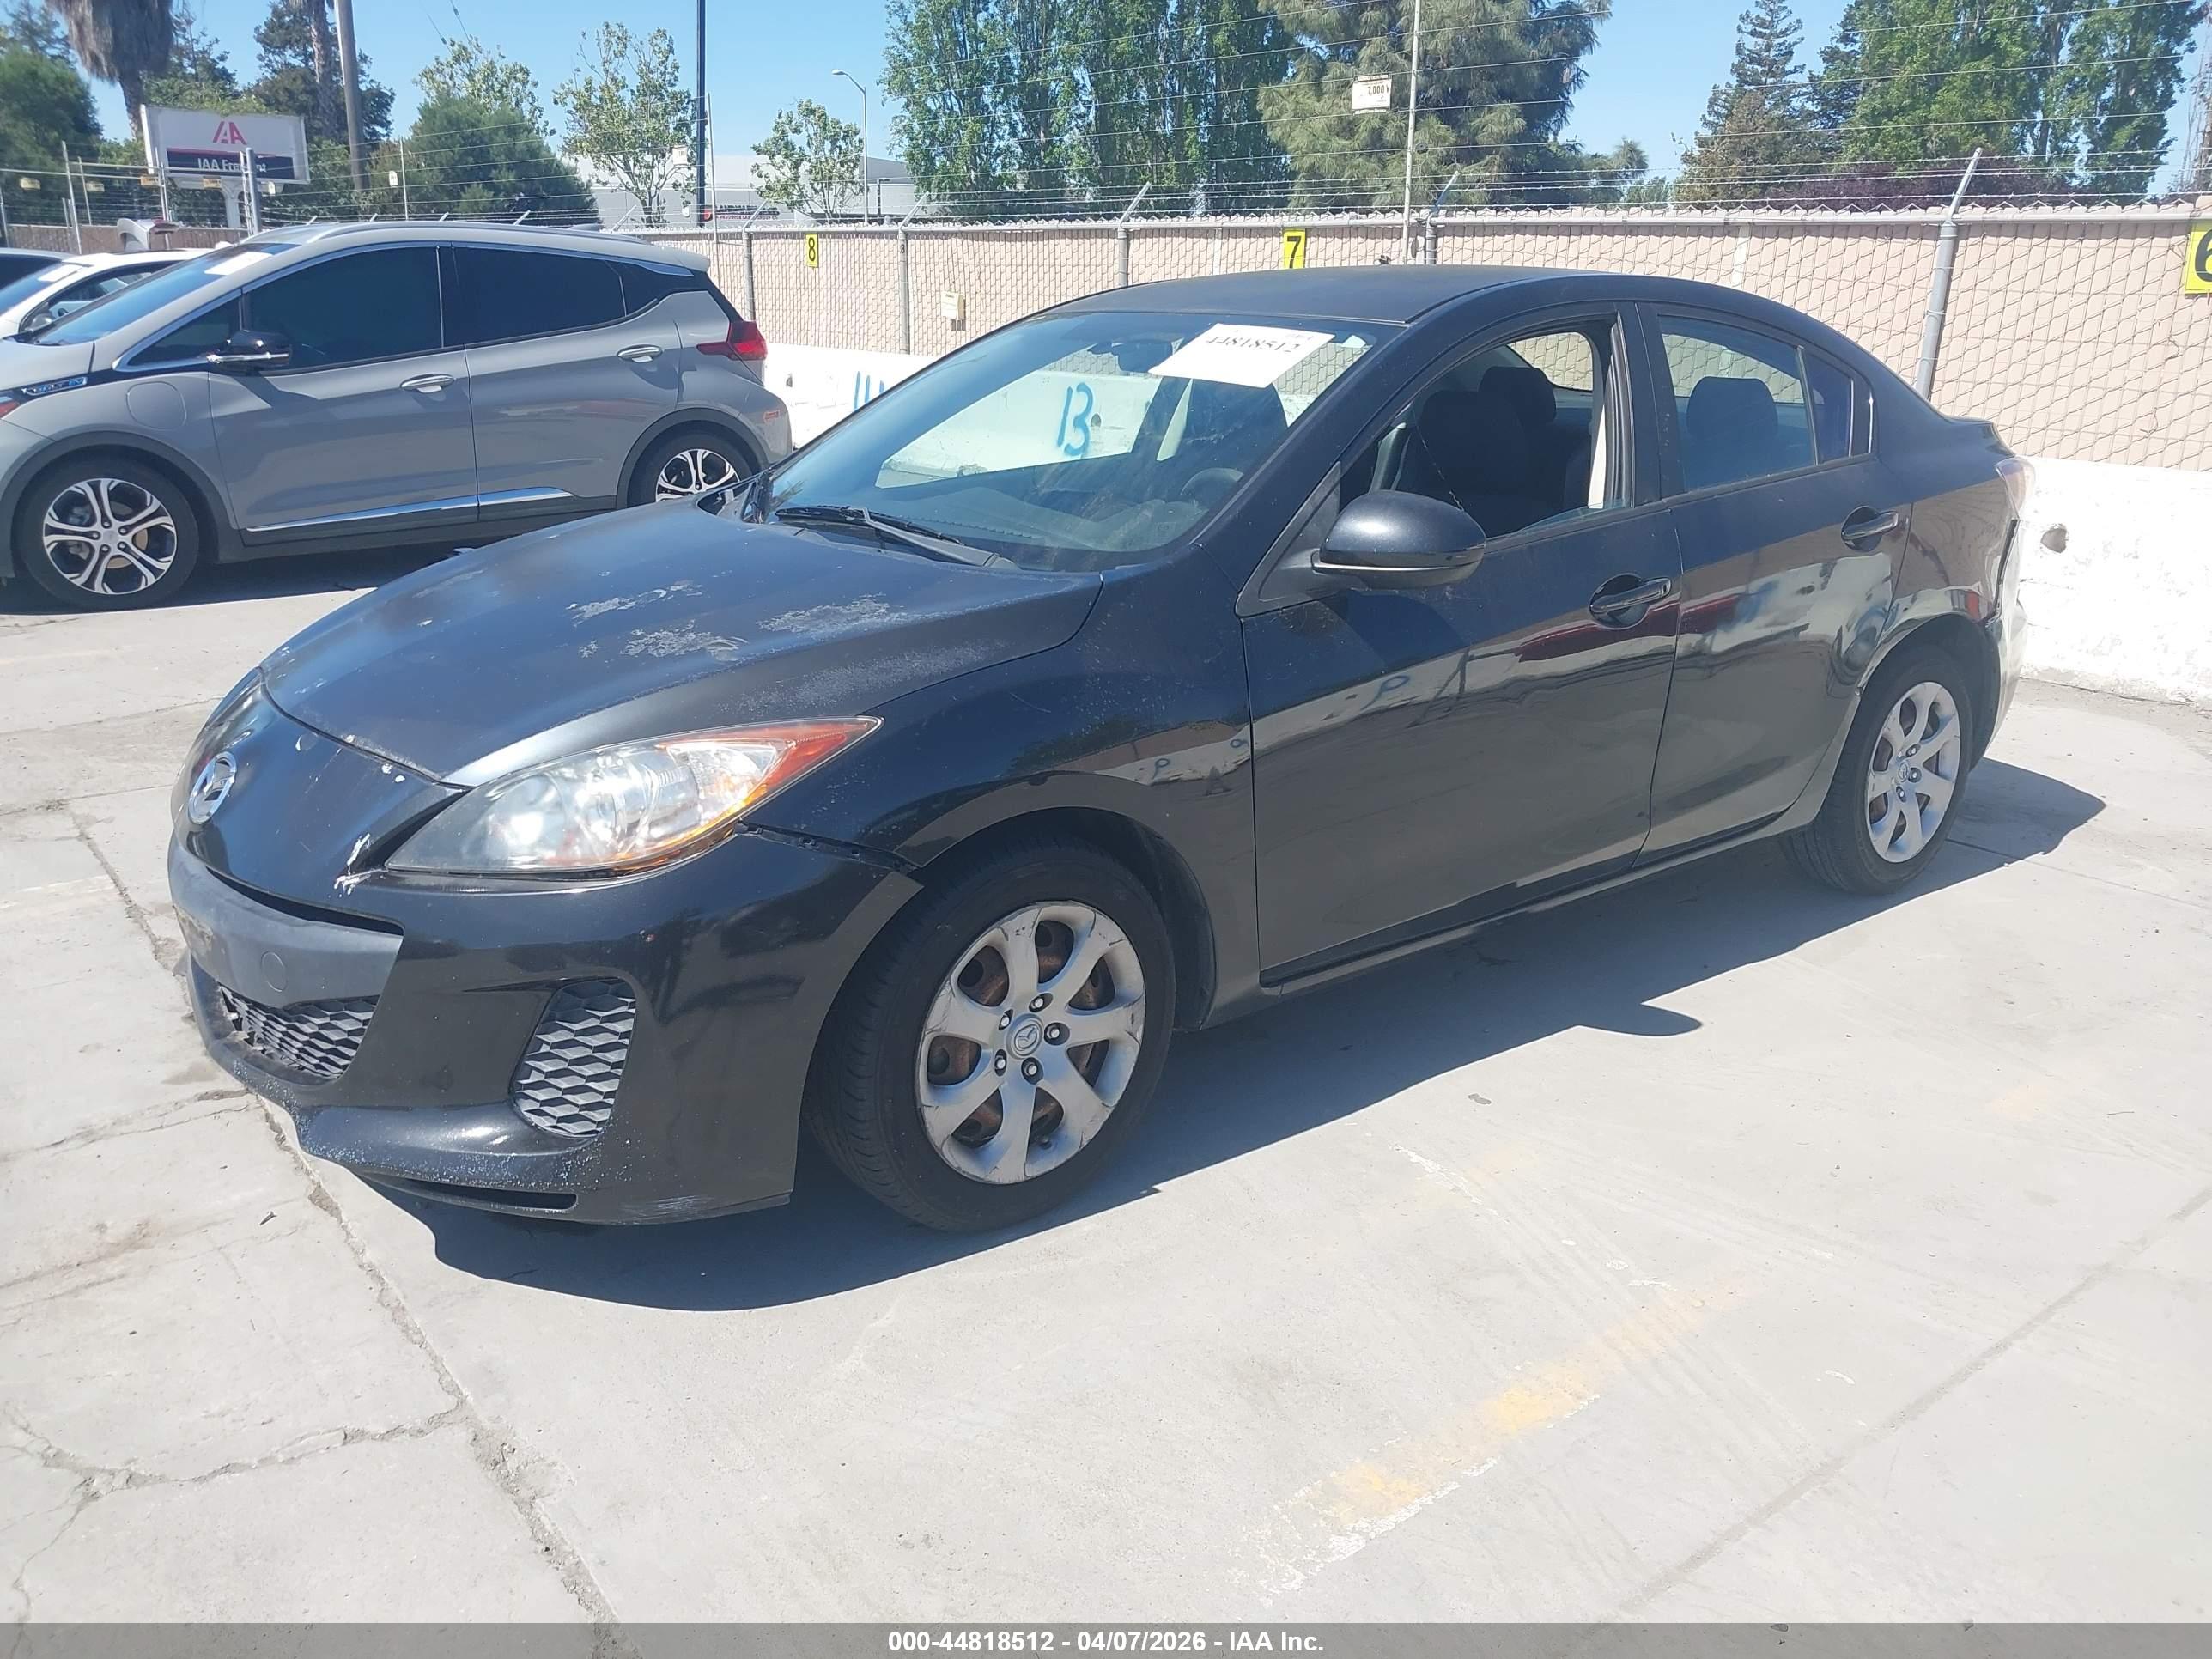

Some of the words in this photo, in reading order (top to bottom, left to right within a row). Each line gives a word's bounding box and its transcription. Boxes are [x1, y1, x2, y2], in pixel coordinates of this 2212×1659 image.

[198, 157, 220, 170] IAA
[807, 236, 817, 262] 8
[1286, 235, 1302, 269] 7
[1056, 381, 1095, 459] 13
